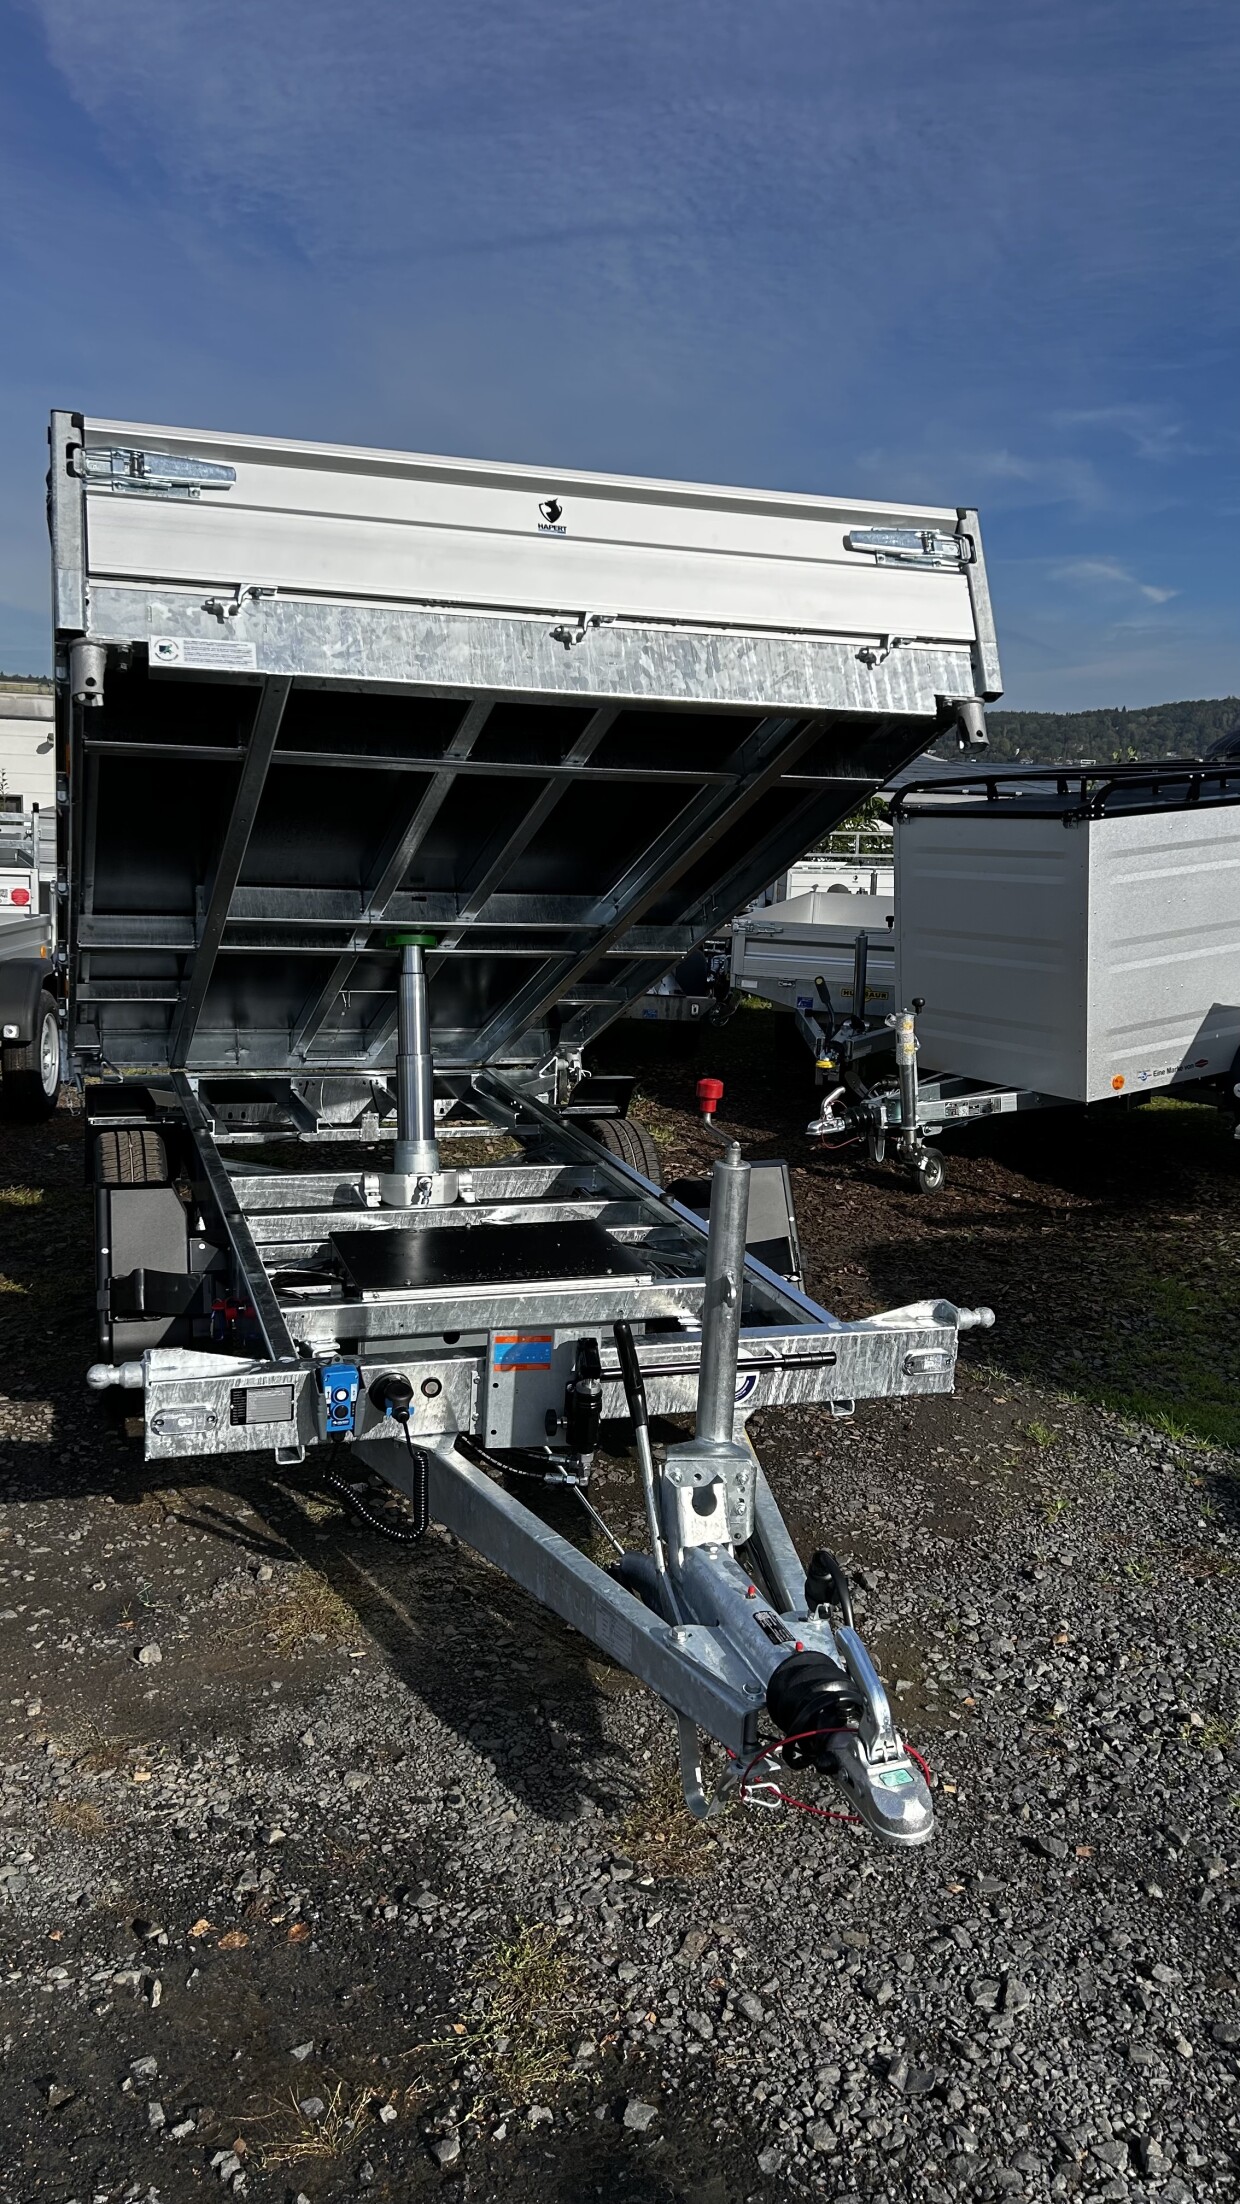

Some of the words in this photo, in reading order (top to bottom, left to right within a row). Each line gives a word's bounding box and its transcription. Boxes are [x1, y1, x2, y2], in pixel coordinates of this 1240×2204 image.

[538, 523, 567, 532] HAPERT
[843, 990, 887, 999] HUAUR
[1166, 1066, 1183, 1074] Marke
